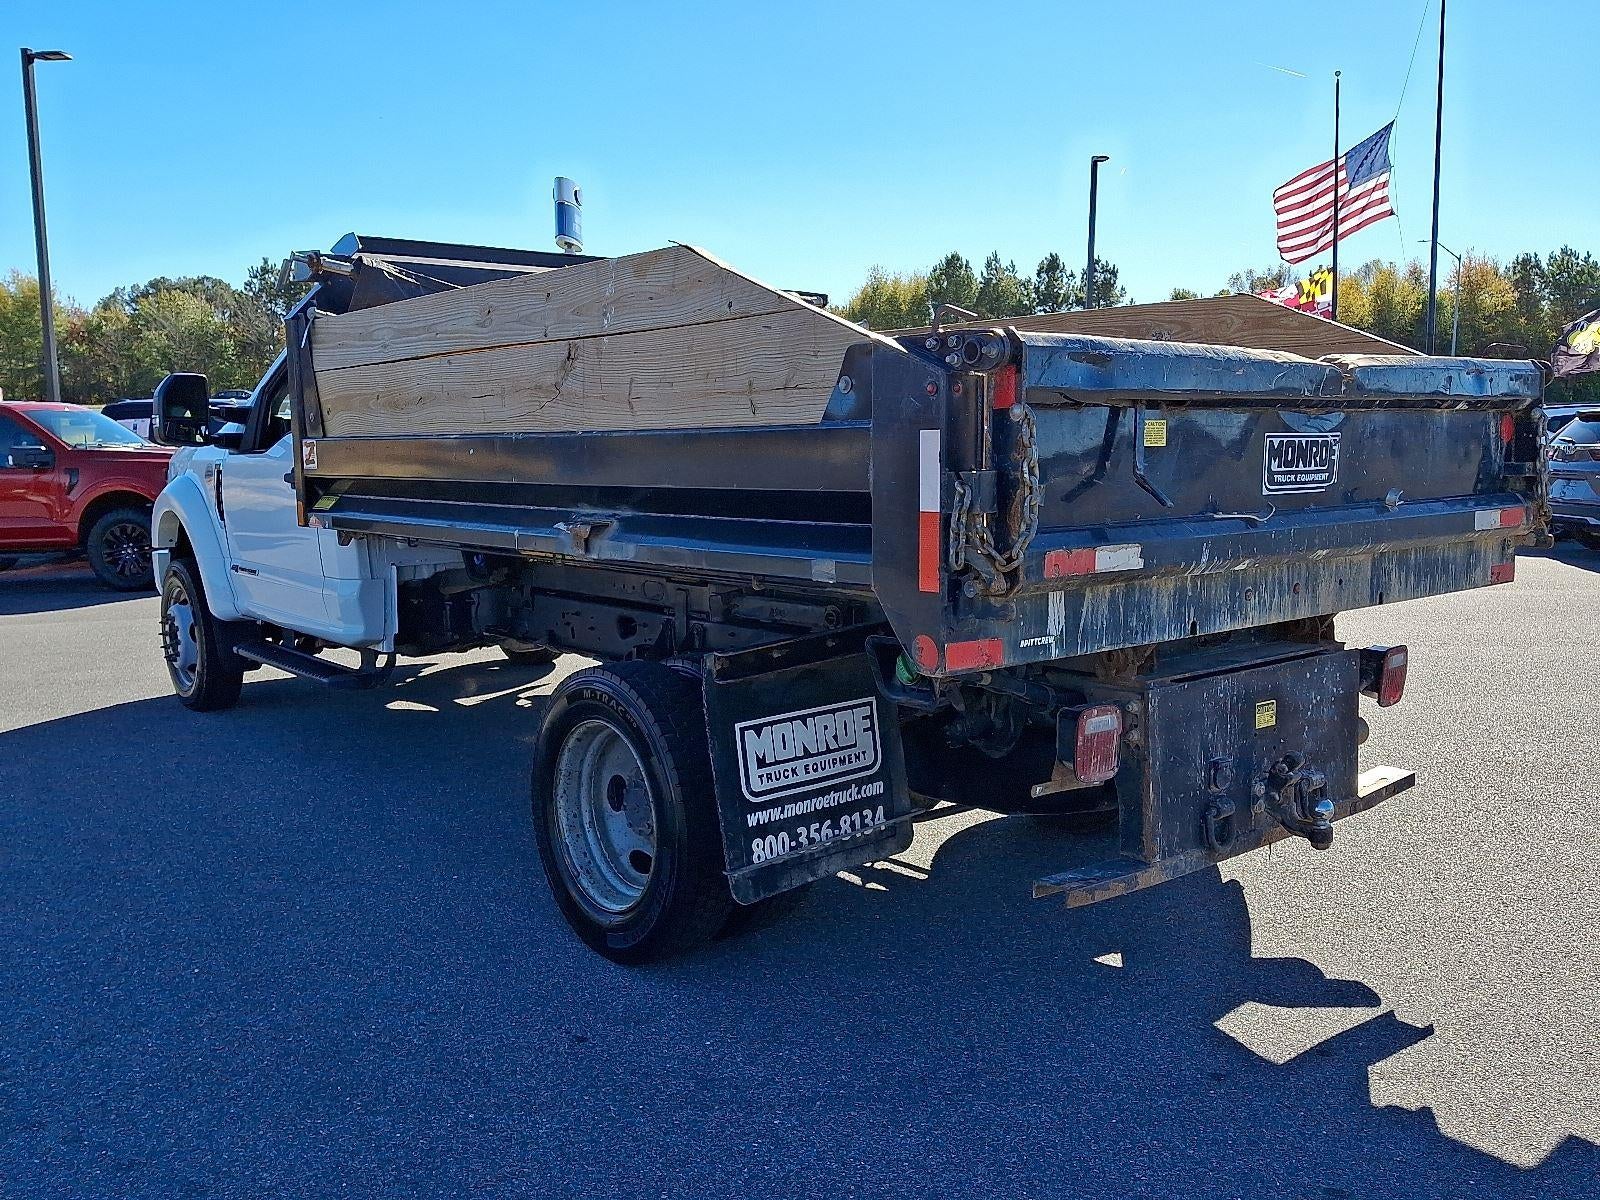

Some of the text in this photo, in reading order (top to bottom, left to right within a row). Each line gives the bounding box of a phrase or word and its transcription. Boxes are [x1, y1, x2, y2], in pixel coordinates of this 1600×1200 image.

[1268, 439, 1337, 469] MONROE
[1273, 472, 1330, 483] TRUCK EQUIPMENT
[744, 706, 873, 764] MONROE
[757, 750, 868, 786] TRUCK EQUIPMENT
[746, 781, 885, 828] www.monroetruck.com
[751, 805, 887, 865] 800-356-8134
